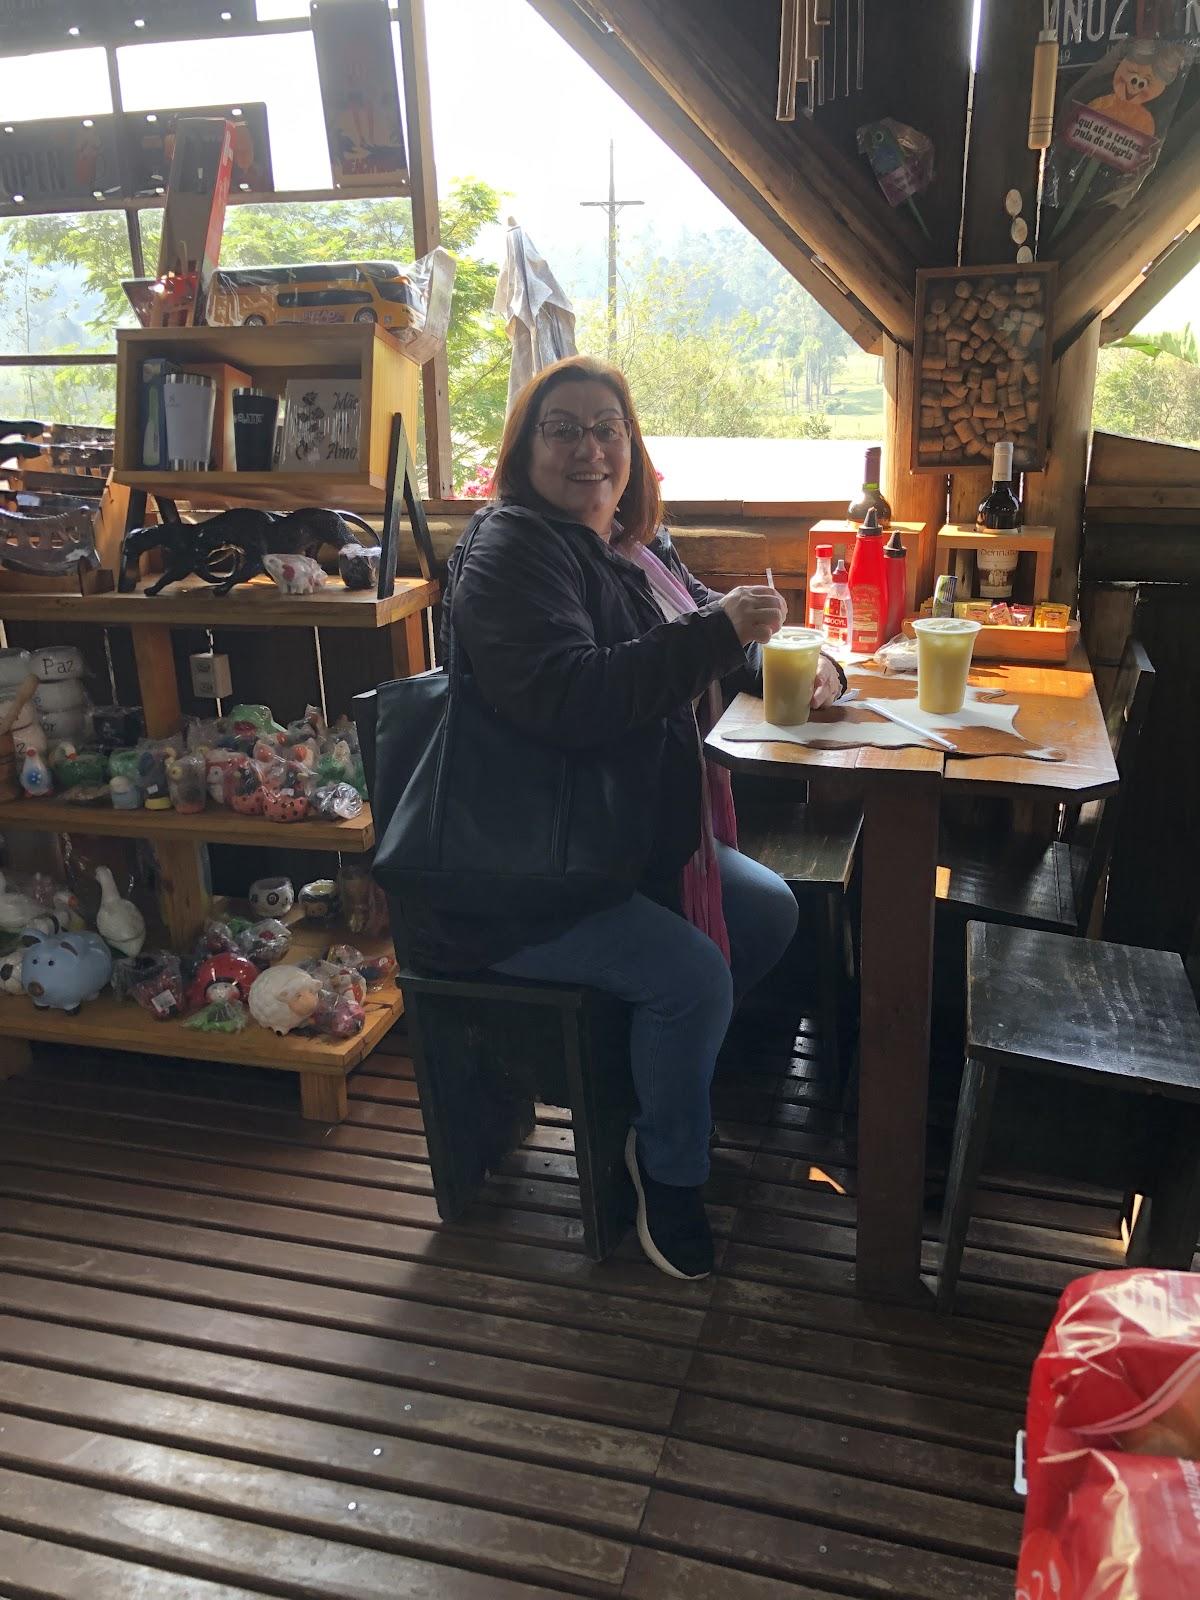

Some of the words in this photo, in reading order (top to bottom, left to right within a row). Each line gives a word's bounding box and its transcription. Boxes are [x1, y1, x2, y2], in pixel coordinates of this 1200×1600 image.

[1072, 129, 1093, 142] pula
[1093, 136, 1104, 147] de
[1103, 142, 1133, 160] alegria
[1093, 124, 1109, 136] até
[1114, 133, 1142, 151] tristez
[42, 658, 73, 675] Paz
